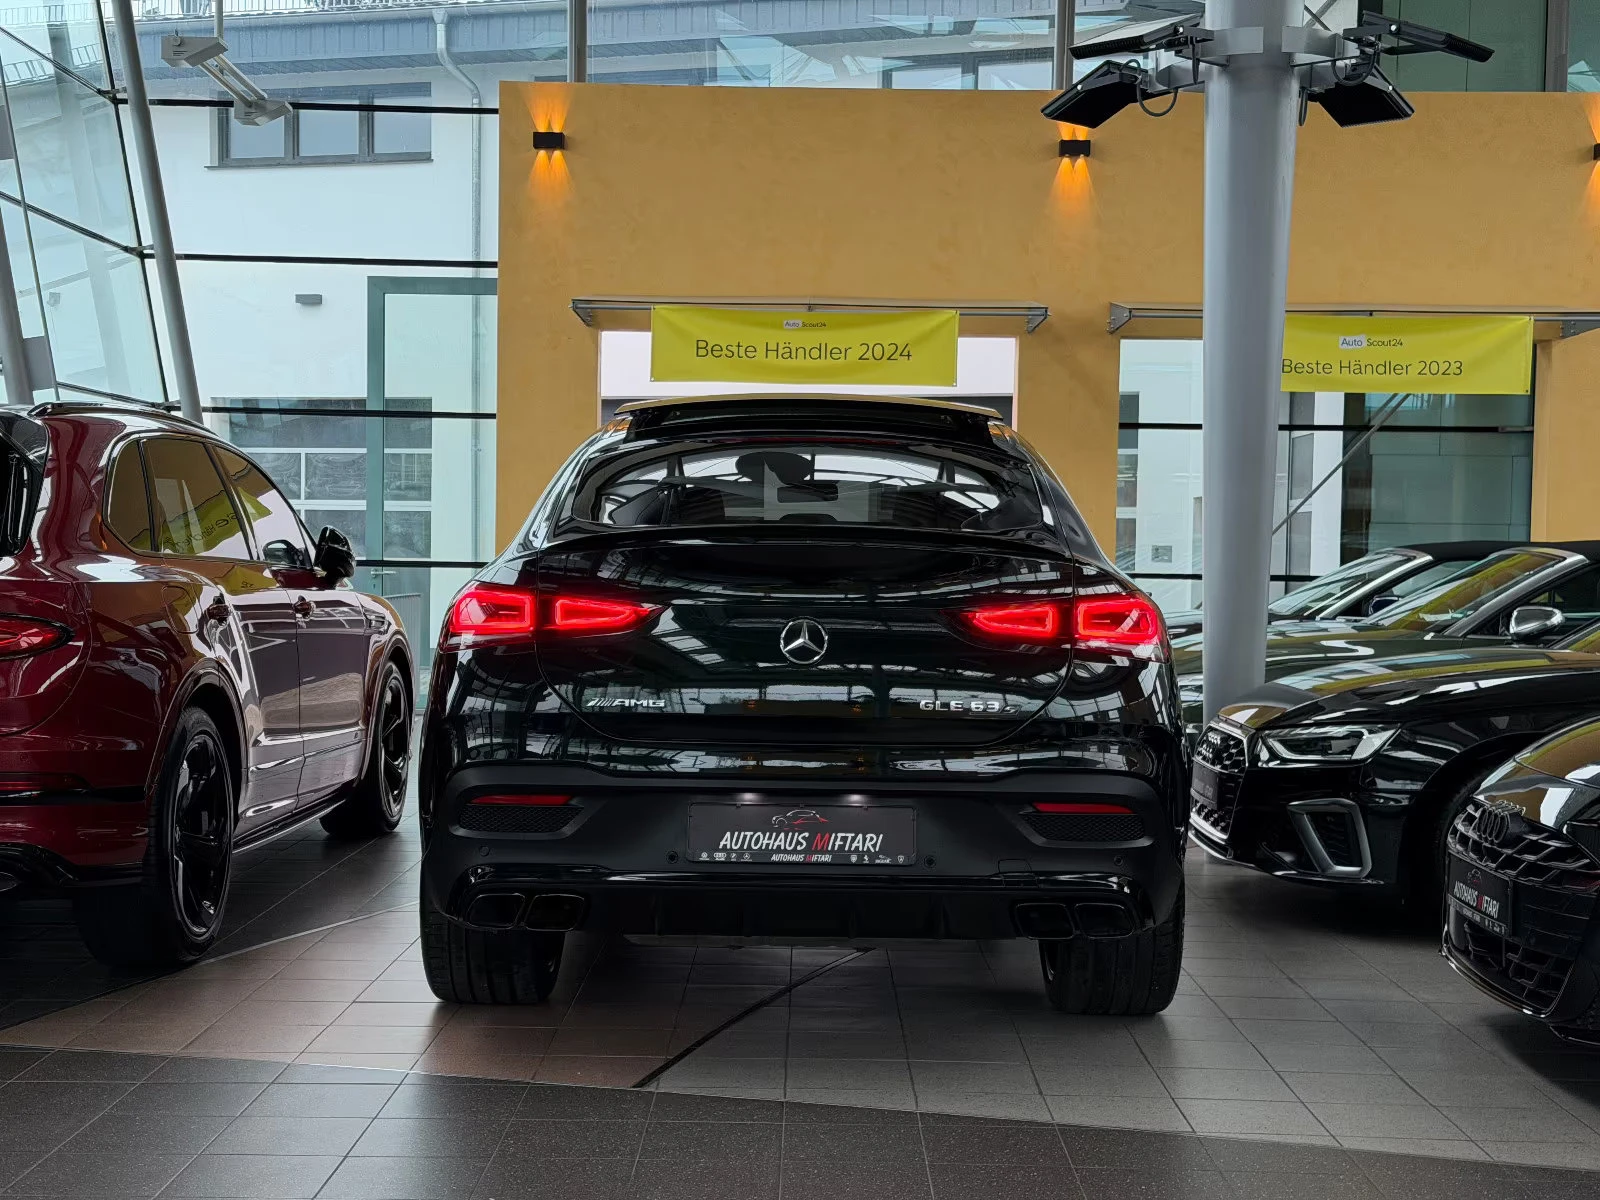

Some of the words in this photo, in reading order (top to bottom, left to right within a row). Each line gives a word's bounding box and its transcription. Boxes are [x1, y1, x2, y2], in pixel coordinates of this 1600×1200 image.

[1340, 337, 1363, 347] Auto
[1366, 338, 1404, 347] Scout24
[695, 339, 757, 359] Beste
[764, 341, 852, 361] Händler
[858, 342, 912, 361] 2024
[1281, 358, 1333, 375] Beste
[1339, 359, 1412, 376] Händler
[1417, 360, 1463, 376] 2023
[919, 700, 964, 711] GLE
[970, 701, 1000, 712] 63
[718, 831, 810, 851] AUTOHAUS
[811, 832, 884, 852] MIFTARI
[770, 854, 805, 862] AUTOHAUS
[805, 854, 833, 863] MIFTARI
